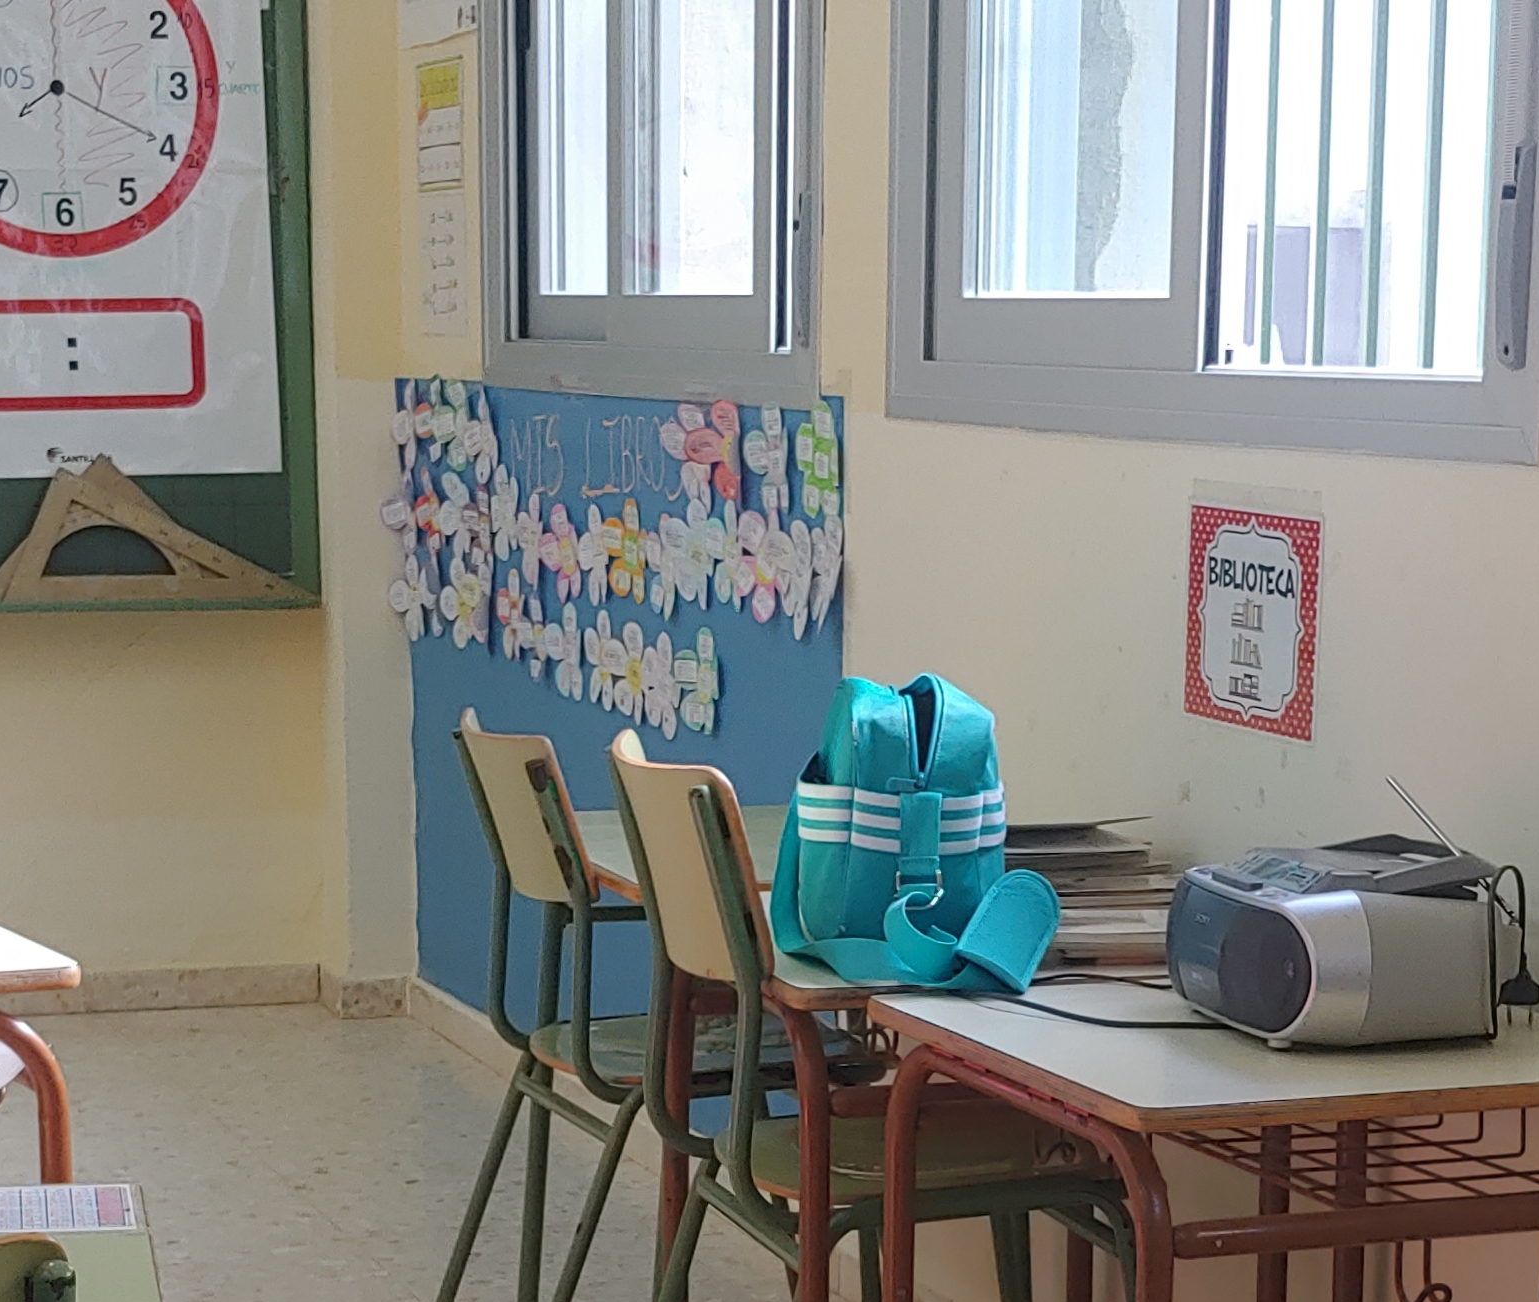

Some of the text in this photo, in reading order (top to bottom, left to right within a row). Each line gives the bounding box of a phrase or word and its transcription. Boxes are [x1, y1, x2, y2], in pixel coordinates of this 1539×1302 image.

[149, 10, 169, 39] 2
[170, 72, 188, 101] 3
[159, 134, 178, 162] 4
[119, 177, 137, 206] 5
[56, 198, 75, 227] 6
[510, 413, 563, 497] MIS
[1209, 556, 1295, 598] BIBLIOTECA
